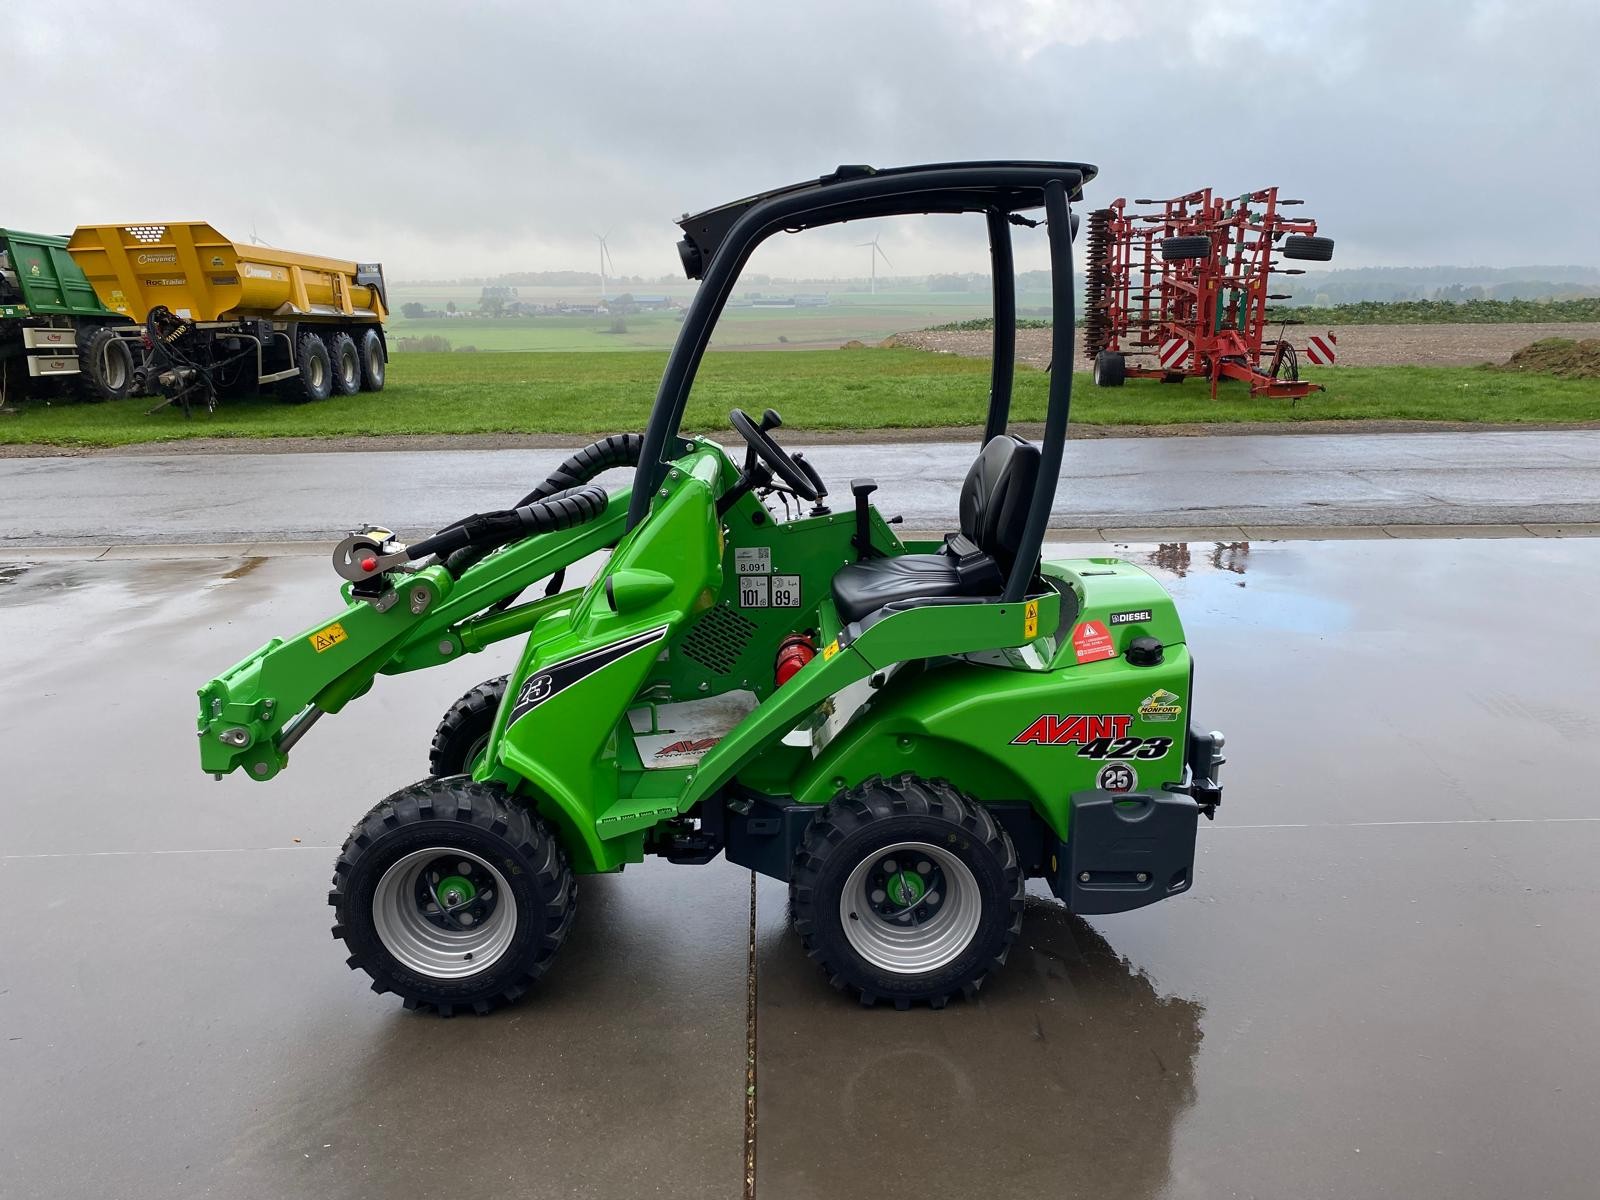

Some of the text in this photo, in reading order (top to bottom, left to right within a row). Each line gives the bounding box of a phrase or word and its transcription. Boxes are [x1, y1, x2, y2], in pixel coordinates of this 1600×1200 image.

[740, 563, 766, 572] 8.091
[742, 589, 758, 606] 101
[775, 590, 790, 606] 89
[1119, 612, 1151, 622] DIESEL
[1009, 714, 1133, 746] AVANT
[1076, 737, 1174, 761] 423
[1105, 770, 1129, 789] 25
